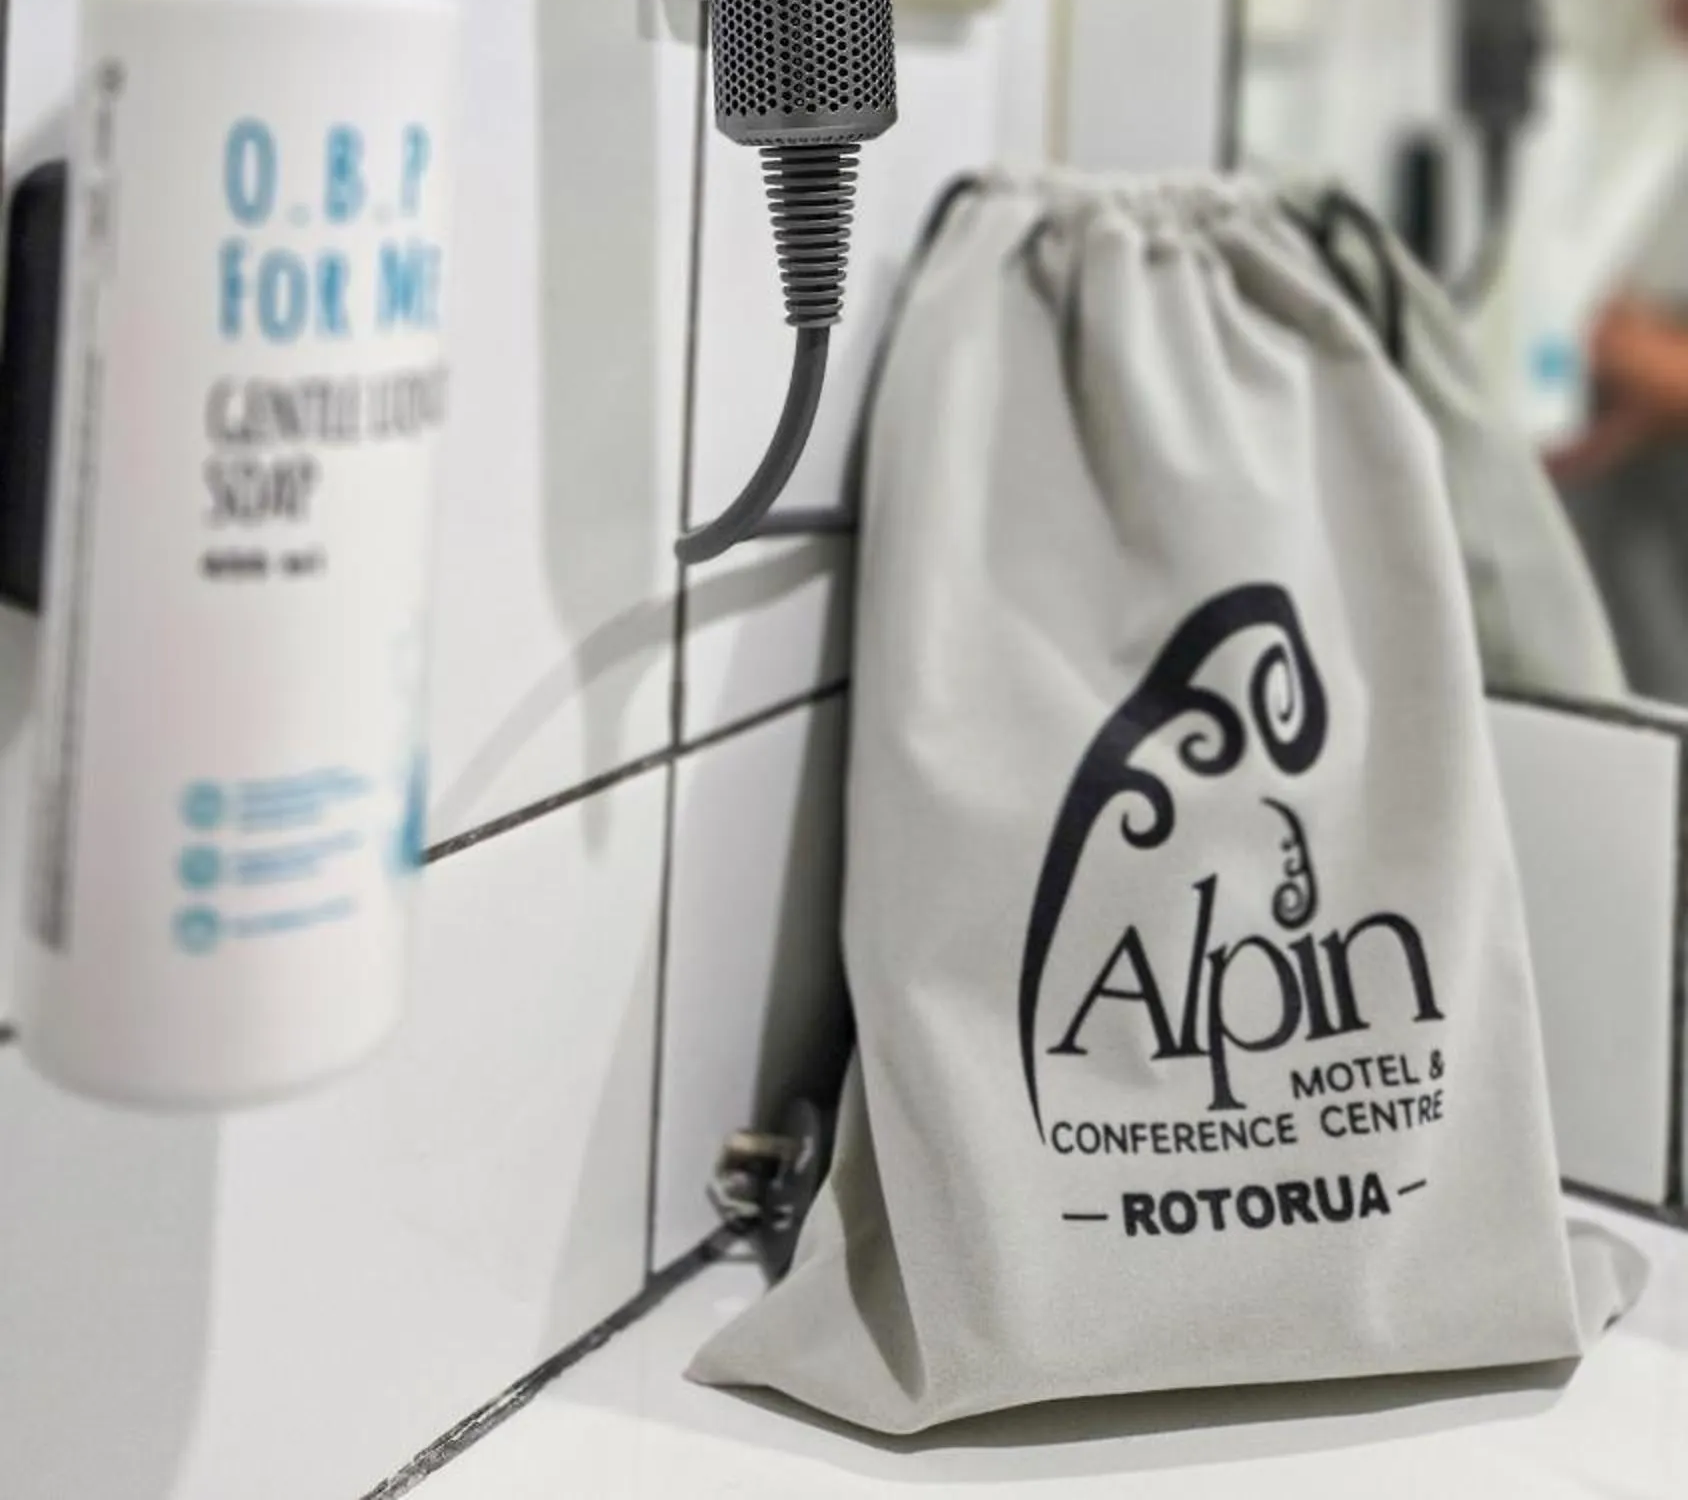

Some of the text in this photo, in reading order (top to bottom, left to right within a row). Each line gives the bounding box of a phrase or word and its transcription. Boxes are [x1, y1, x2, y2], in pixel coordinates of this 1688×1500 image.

[217, 235, 353, 341] FOR
[1046, 873, 1446, 1112] Alpin
[1290, 1049, 1445, 1100] MOTEL &
[1051, 1090, 1444, 1155] CONFERENCE CENTRE
[1121, 1172, 1392, 1238] ROTORUA
